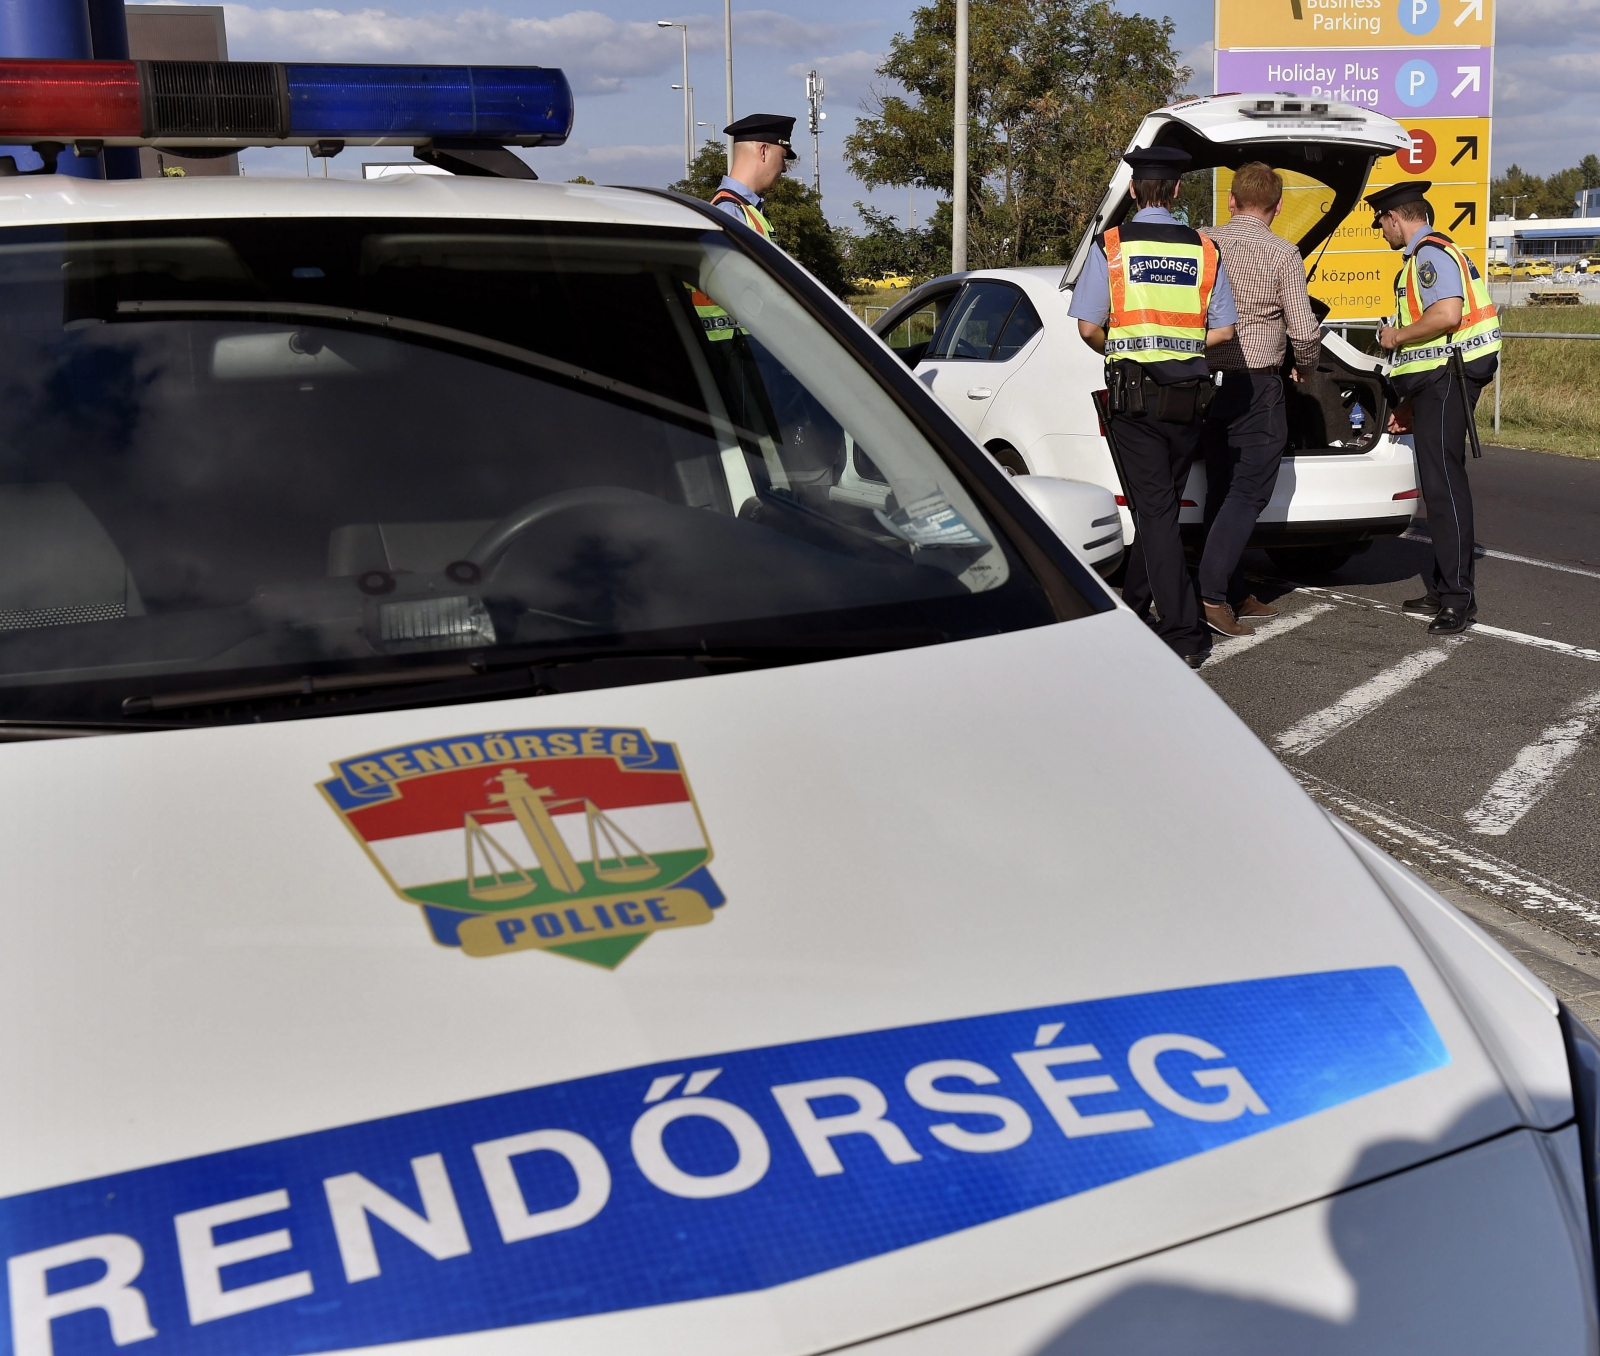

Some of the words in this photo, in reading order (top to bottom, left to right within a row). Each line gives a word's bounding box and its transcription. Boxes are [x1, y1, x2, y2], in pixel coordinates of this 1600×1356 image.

[1313, 12, 1381, 34] Parking
[1412, 0, 1428, 25] P
[1268, 63, 1336, 85] Holiday
[1344, 63, 1379, 81] Plus
[1409, 70, 1426, 96] P
[1311, 84, 1379, 106] Parking
[1409, 138, 1424, 164] E
[1334, 223, 1381, 239] atering
[1150, 273, 1176, 282] POLICE
[1321, 269, 1381, 284] központ
[1156, 337, 1191, 350] POLICE
[346, 728, 639, 785] RENDŐRSÉG
[495, 897, 677, 945] POLICE
[6, 1021, 1270, 1356] RENDŐRSÉG
